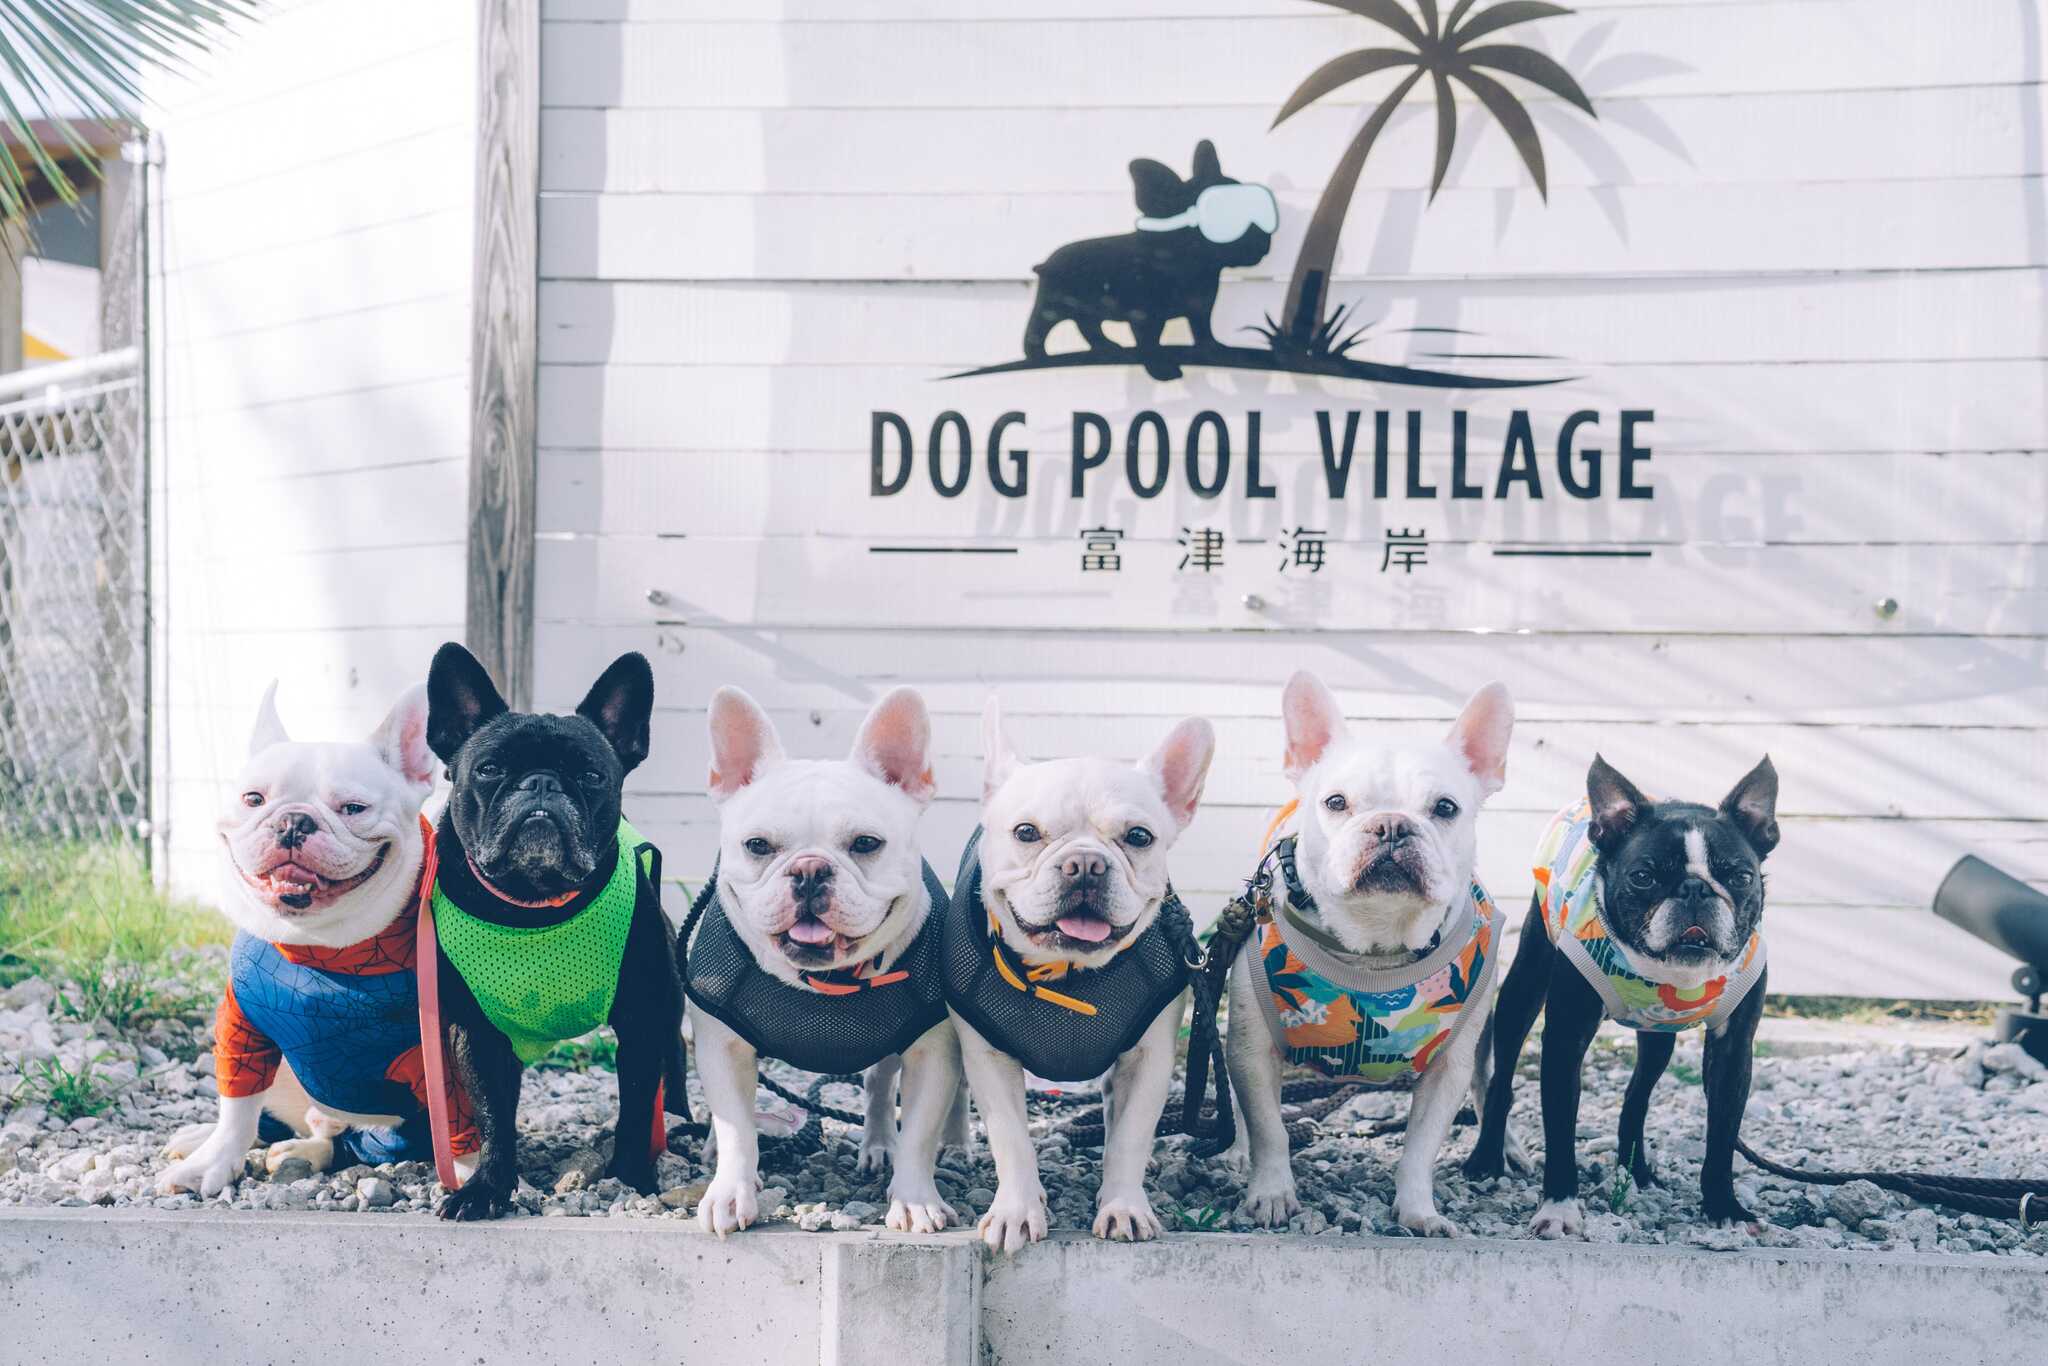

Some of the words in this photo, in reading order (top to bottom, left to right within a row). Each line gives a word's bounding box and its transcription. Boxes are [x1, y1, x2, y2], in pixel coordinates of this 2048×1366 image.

[870, 412, 1029, 498] DOG
[1071, 411, 1277, 499] POOL
[1315, 410, 1655, 500] VILLAGE
[1079, 526, 1429, 574] 富津海岸
